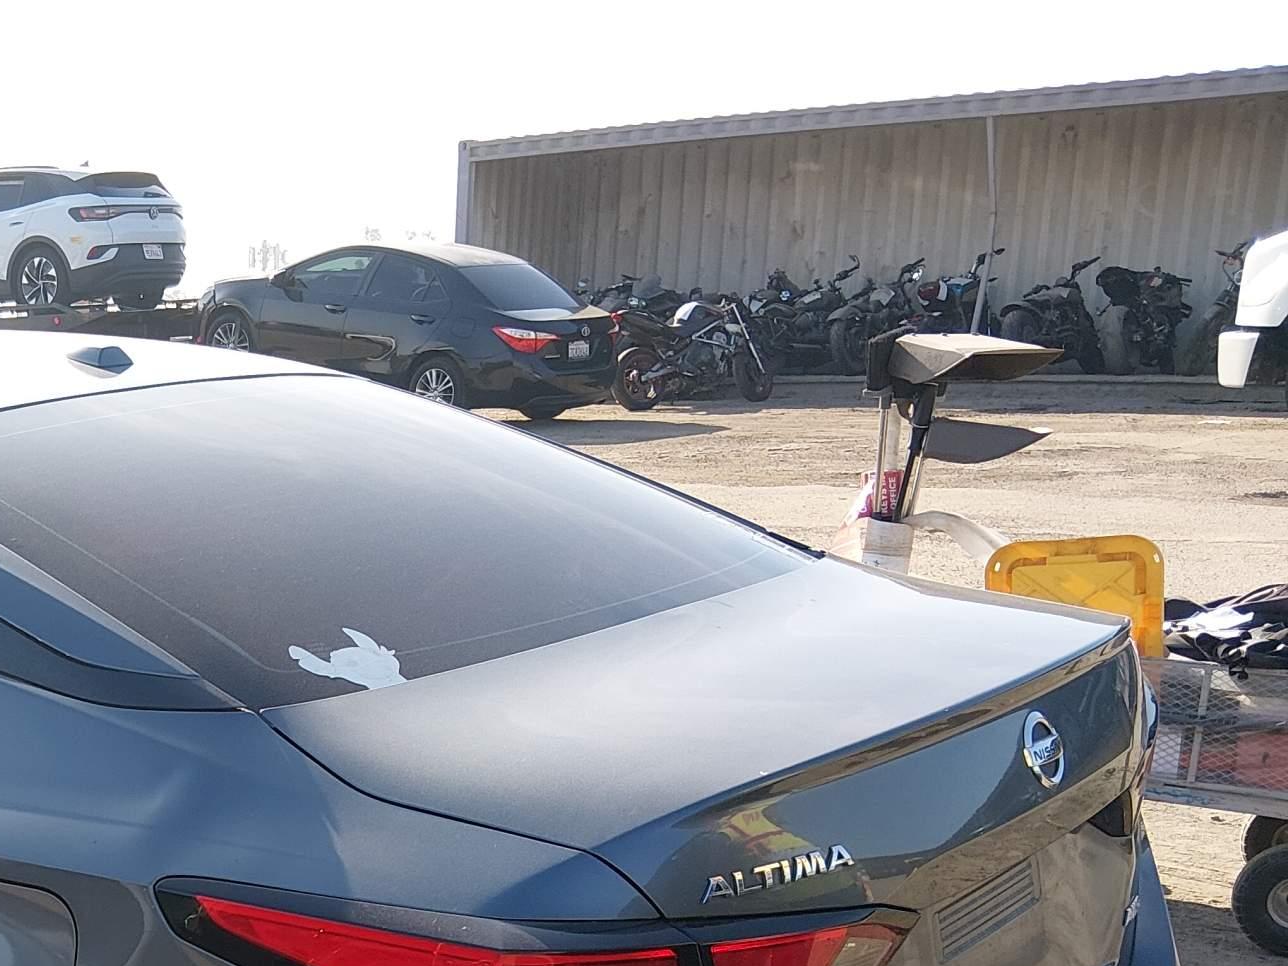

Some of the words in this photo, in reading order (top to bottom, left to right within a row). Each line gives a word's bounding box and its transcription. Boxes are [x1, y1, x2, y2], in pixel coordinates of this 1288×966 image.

[888, 476, 897, 510] OFFICE
[1032, 740, 1058, 762] NISS
[700, 844, 855, 905] ALTIMA
